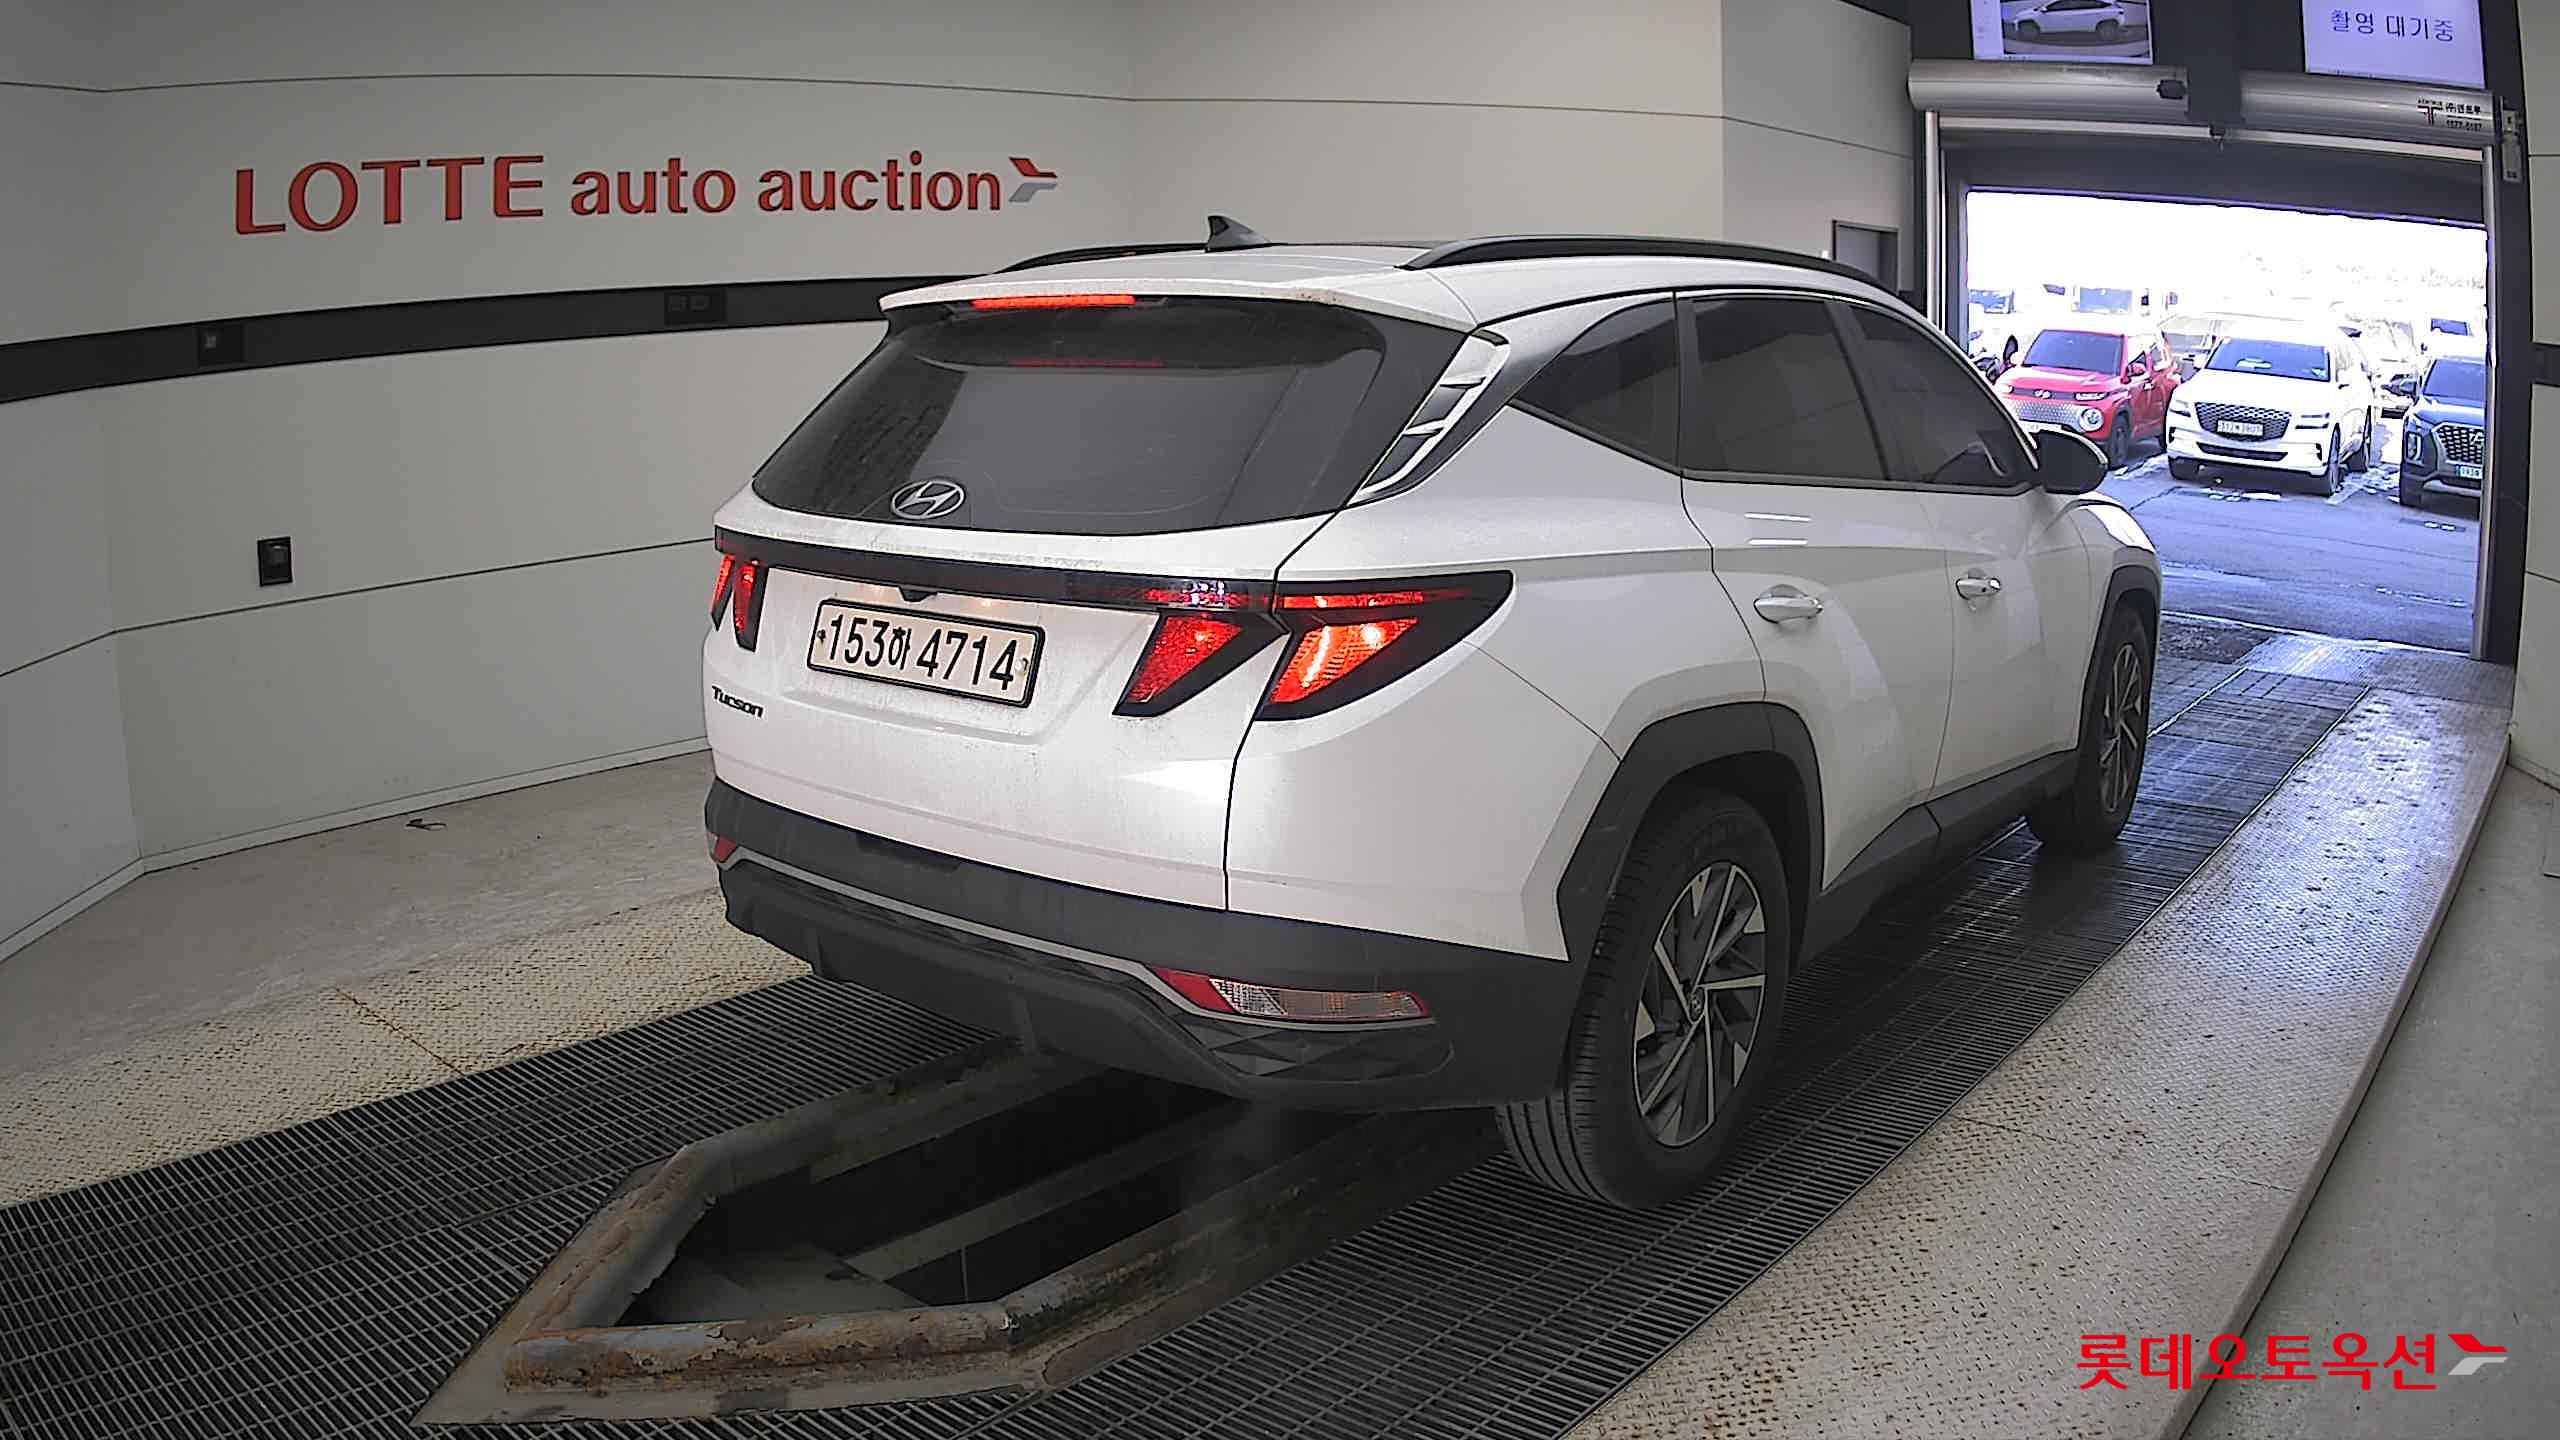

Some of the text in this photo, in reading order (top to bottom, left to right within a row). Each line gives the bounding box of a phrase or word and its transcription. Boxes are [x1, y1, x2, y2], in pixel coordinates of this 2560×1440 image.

[2330, 9, 2454, 42] 촬영 대기중
[235, 150, 1001, 235] LOTTE auto auction
